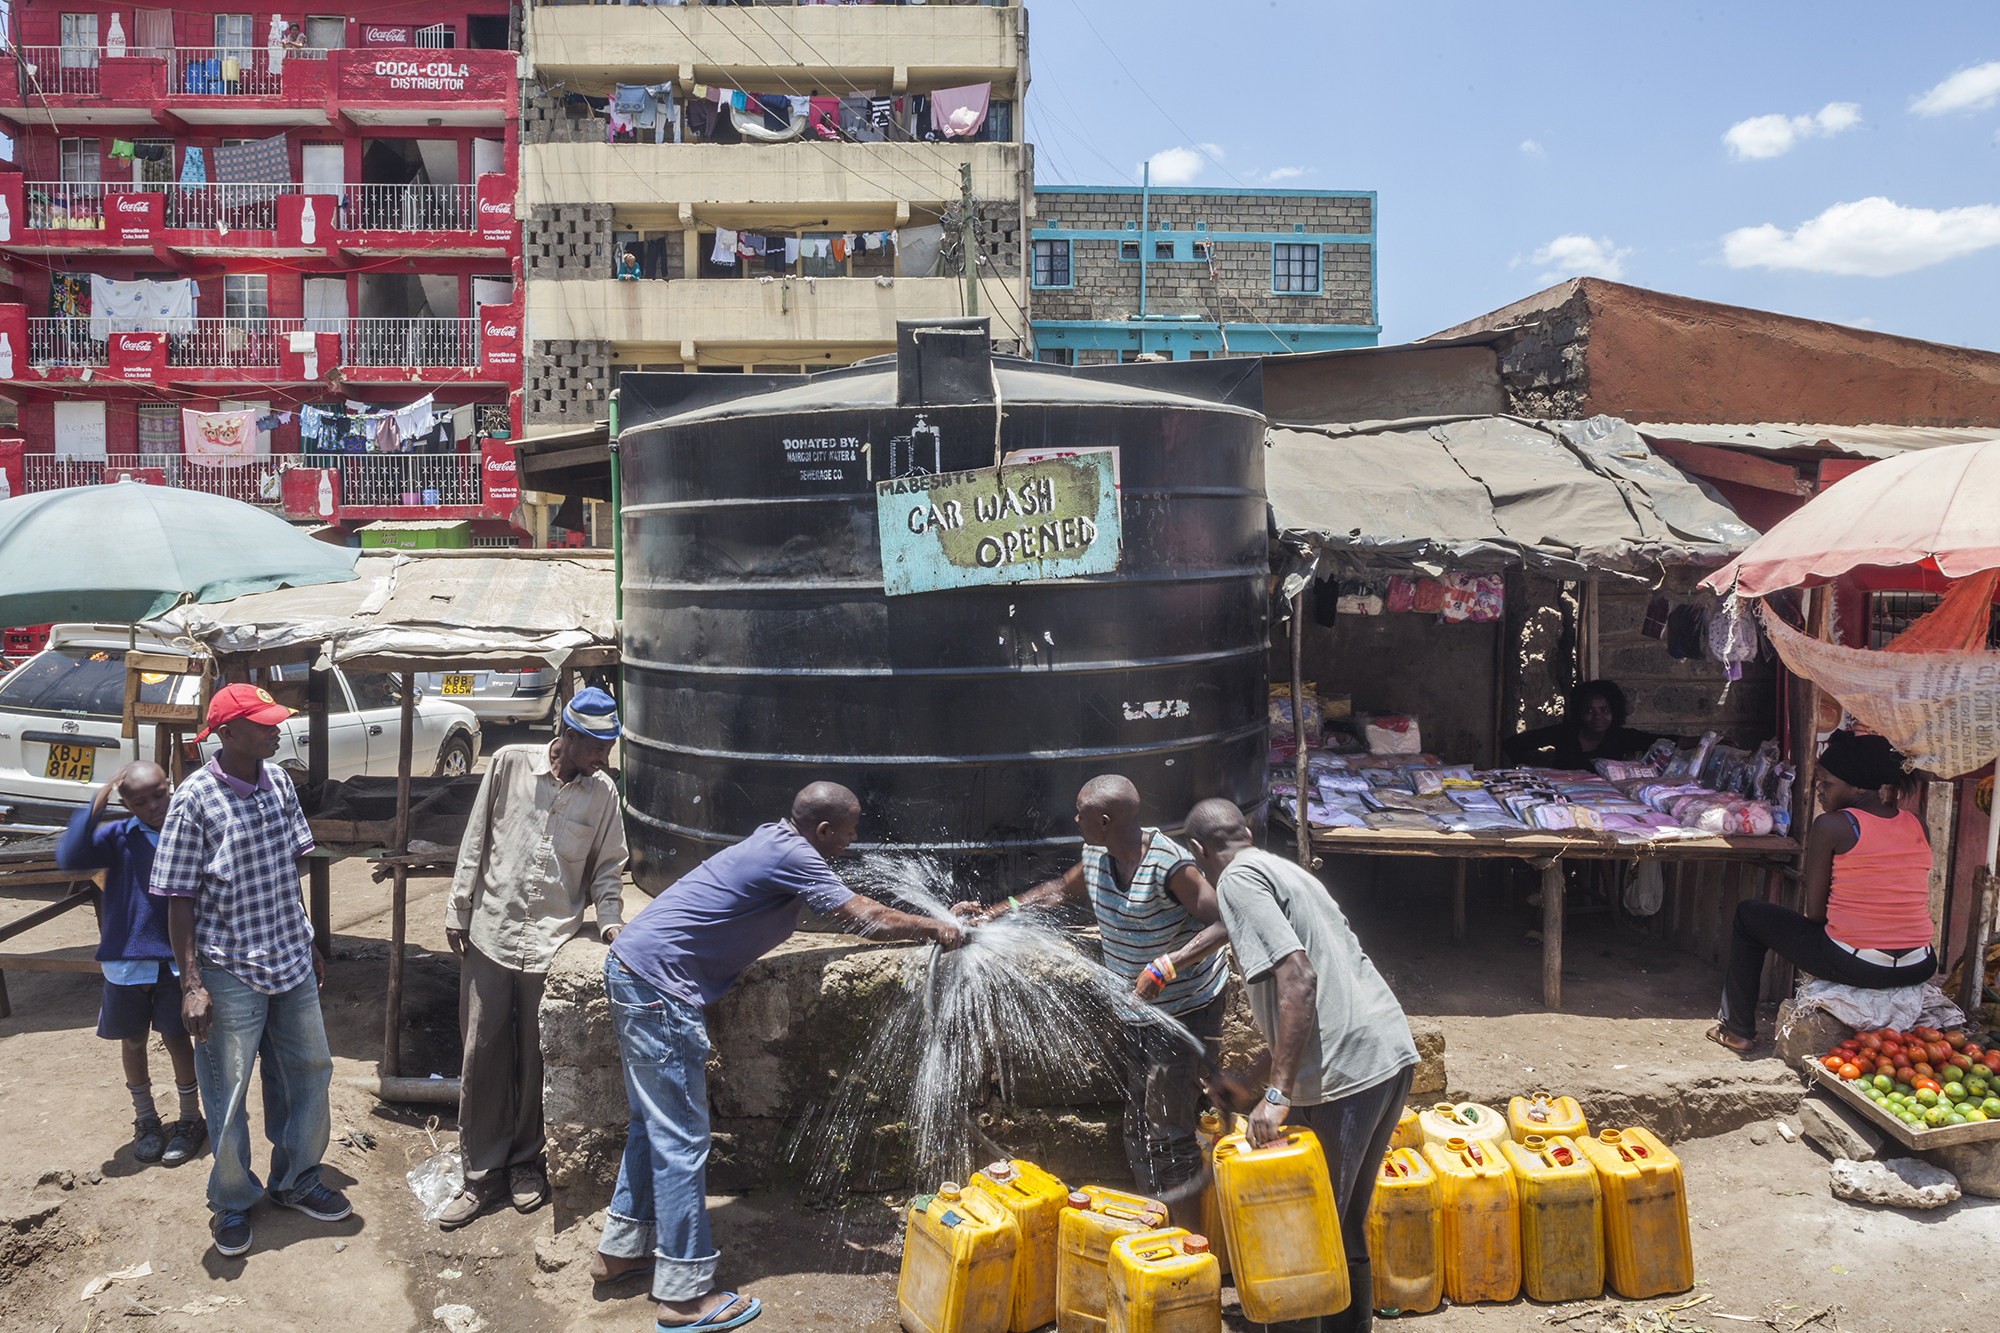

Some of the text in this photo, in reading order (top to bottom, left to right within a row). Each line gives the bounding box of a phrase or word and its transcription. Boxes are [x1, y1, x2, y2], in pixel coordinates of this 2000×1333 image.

[368, 27, 406, 42] Coca-Cola
[375, 61, 469, 77] COCA-COLA
[390, 77, 464, 90] DISTRIBUTOR
[119, 201, 150, 212] Coca-Cola
[481, 202, 512, 214] Coca-Cola
[487, 325, 517, 338] Coca-Cola
[122, 340, 153, 351] Coca-Cola
[782, 437, 859, 450] DONATED BY:
[786, 449, 857, 462] NAIROBI CITY WATER &
[907, 476, 1056, 536] CAR WASH
[975, 515, 1099, 569] OPENED
[446, 675, 468, 686] KBB
[444, 685, 471, 695] 685W
[137, 702, 193, 717] AVAILABLE
[1975, 724, 1994, 757] FLOUR
[49, 744, 82, 764] KBJ
[49, 760, 91, 781] 814F
